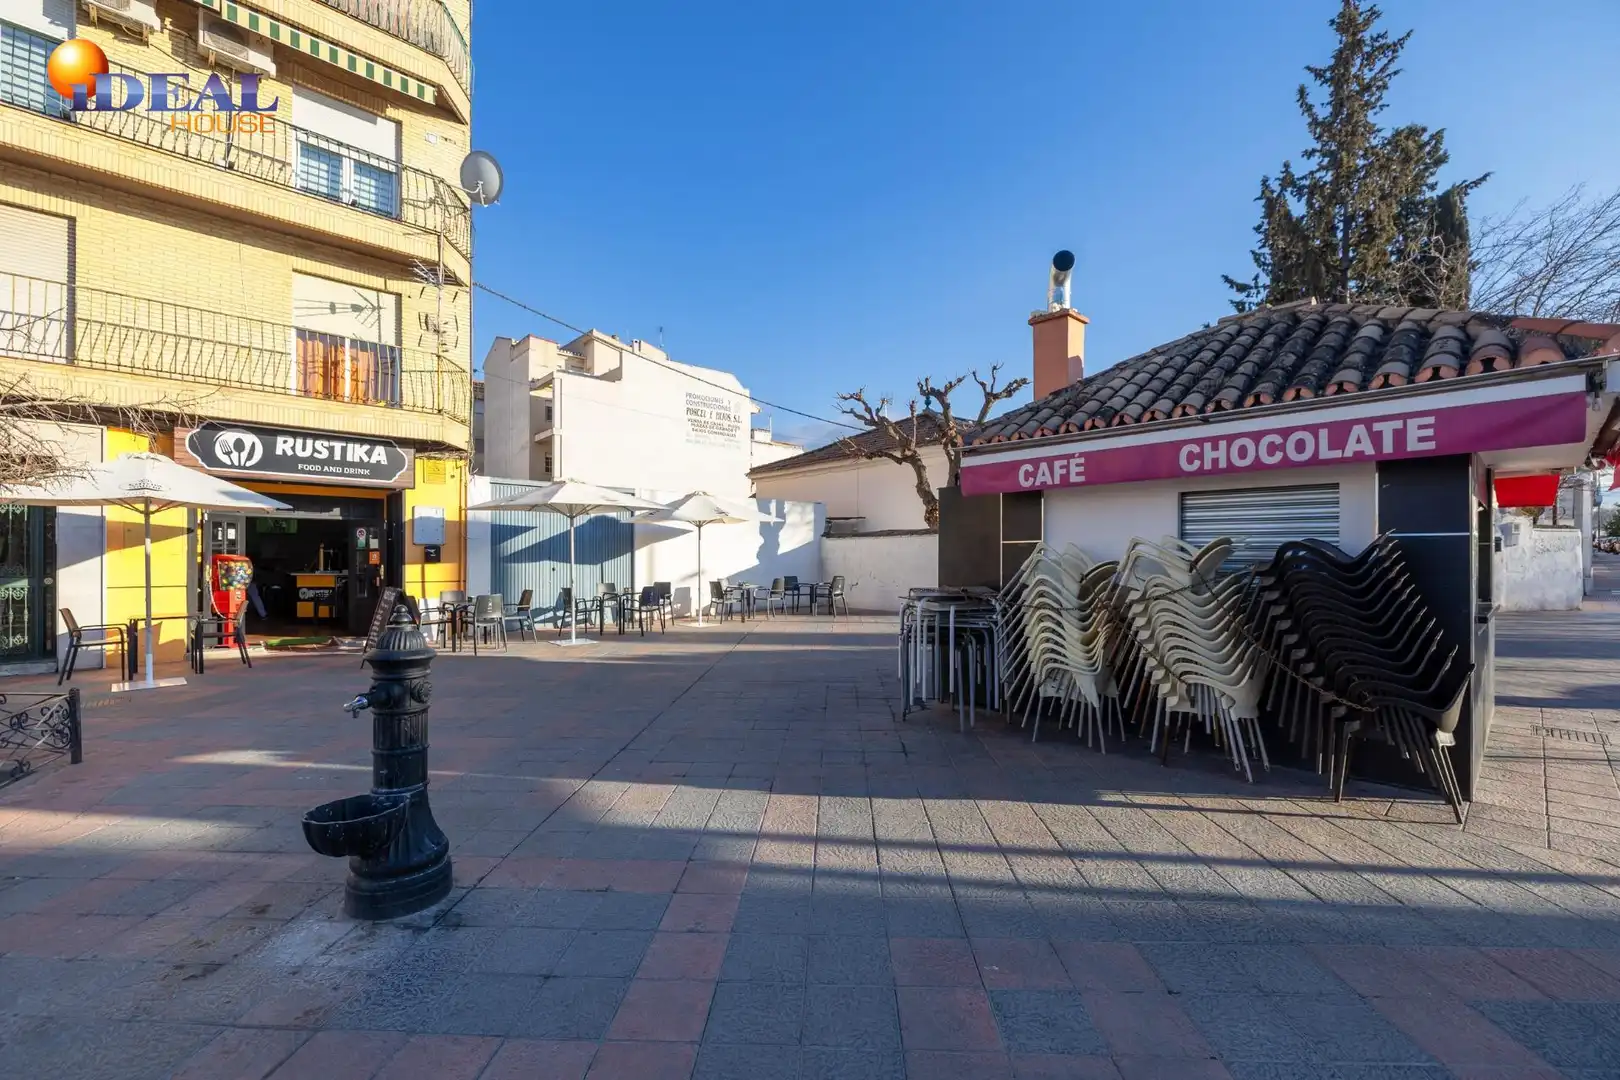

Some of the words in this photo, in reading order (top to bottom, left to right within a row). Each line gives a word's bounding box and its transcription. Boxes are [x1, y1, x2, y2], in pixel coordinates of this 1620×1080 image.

[275, 434, 389, 466] RUSTIKA
[1018, 453, 1085, 488] CAFÉ
[1179, 416, 1436, 473] CHOCOLATE
[298, 463, 321, 472] FOOD
[322, 465, 342, 473] AND
[344, 467, 370, 475] DRINK
